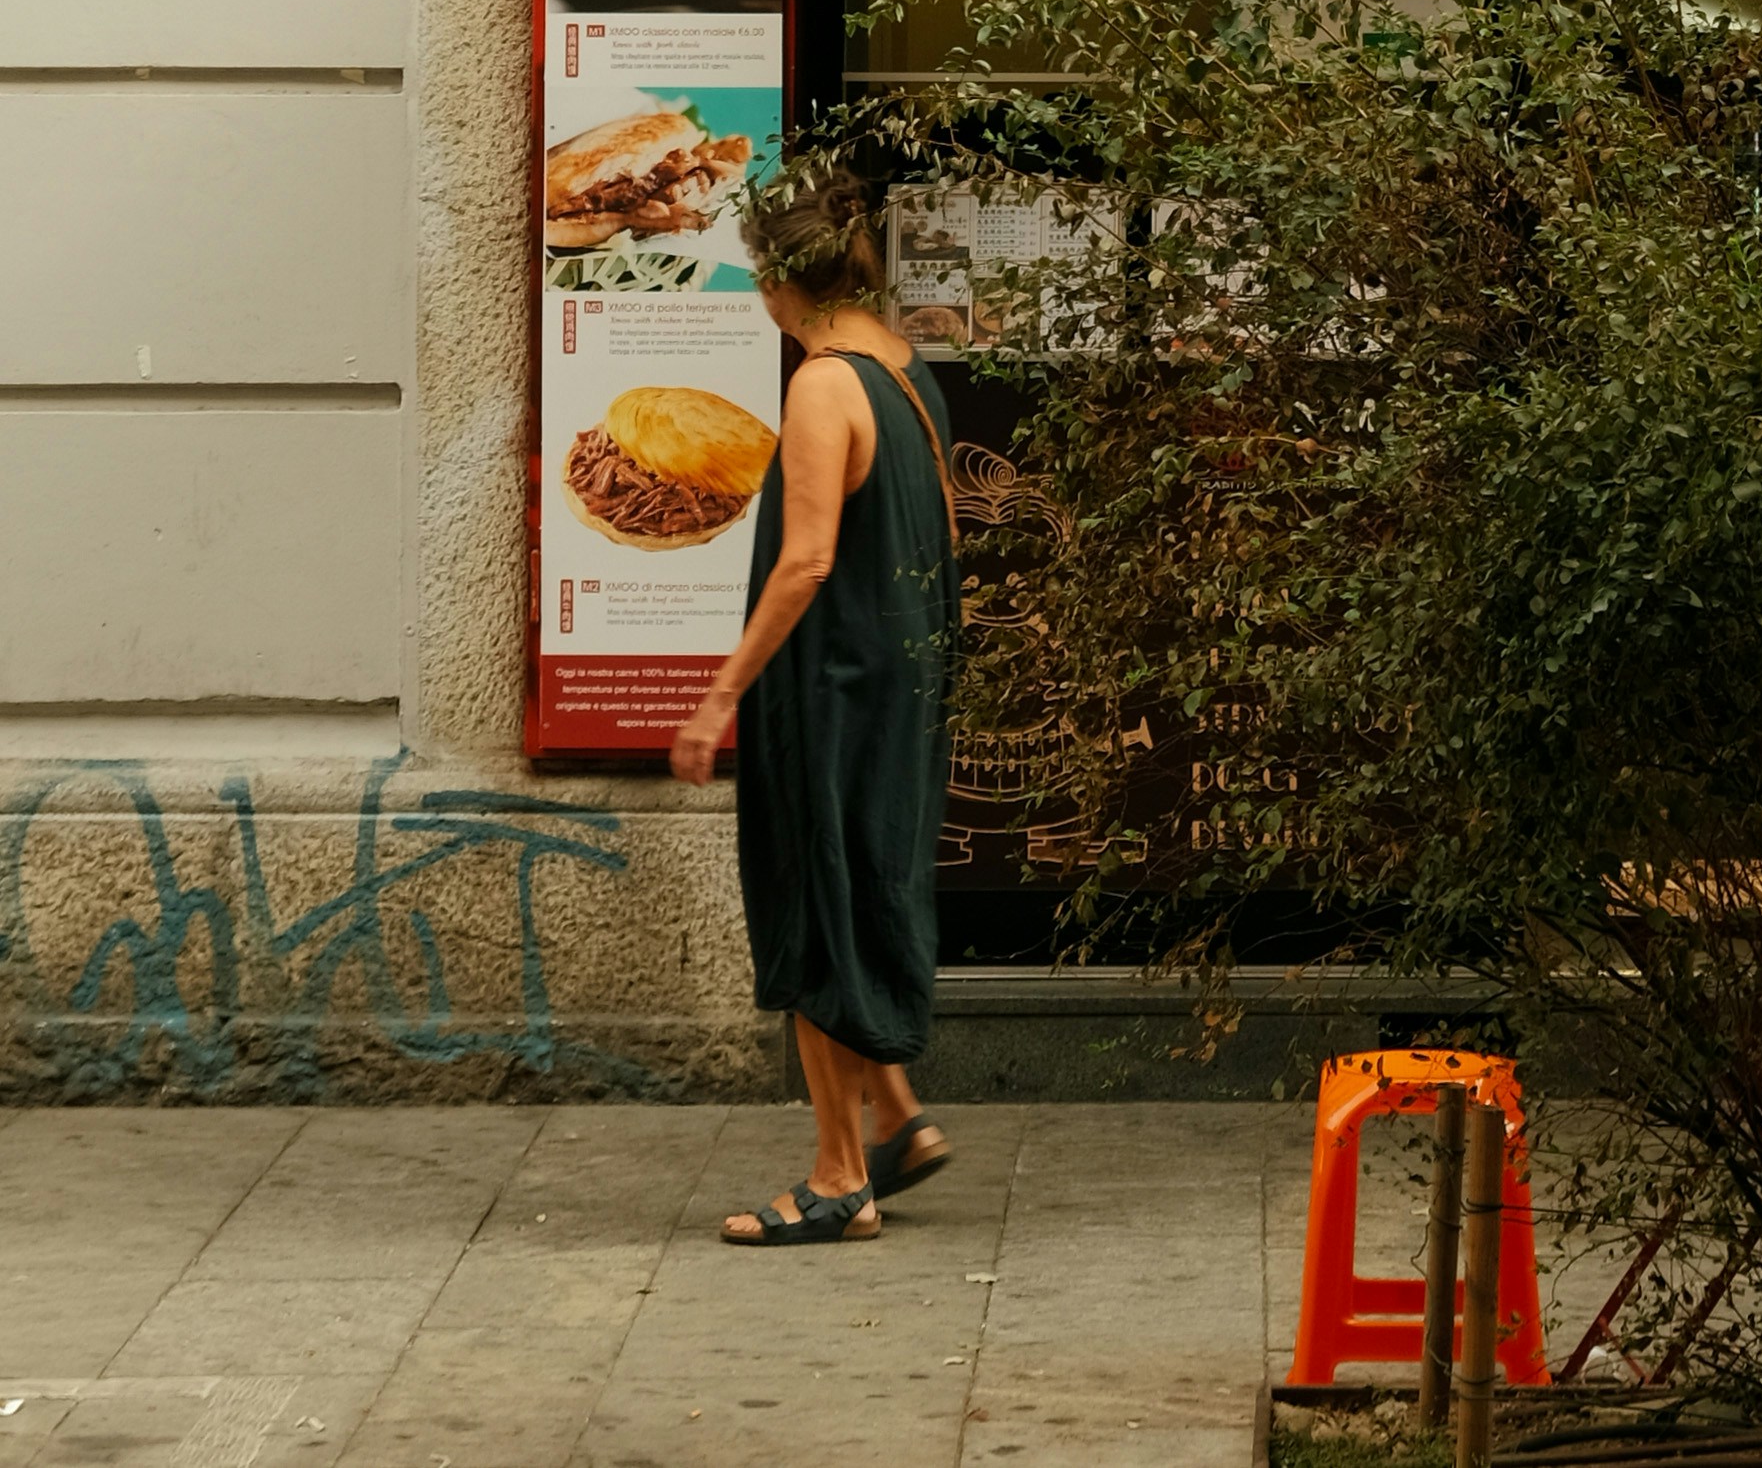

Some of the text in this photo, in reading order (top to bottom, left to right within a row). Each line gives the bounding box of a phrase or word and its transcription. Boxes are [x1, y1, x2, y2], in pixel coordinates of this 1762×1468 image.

[682, 28, 700, 37] con
[641, 668, 665, 677] 100%
[1192, 762, 1298, 793] DOCI
